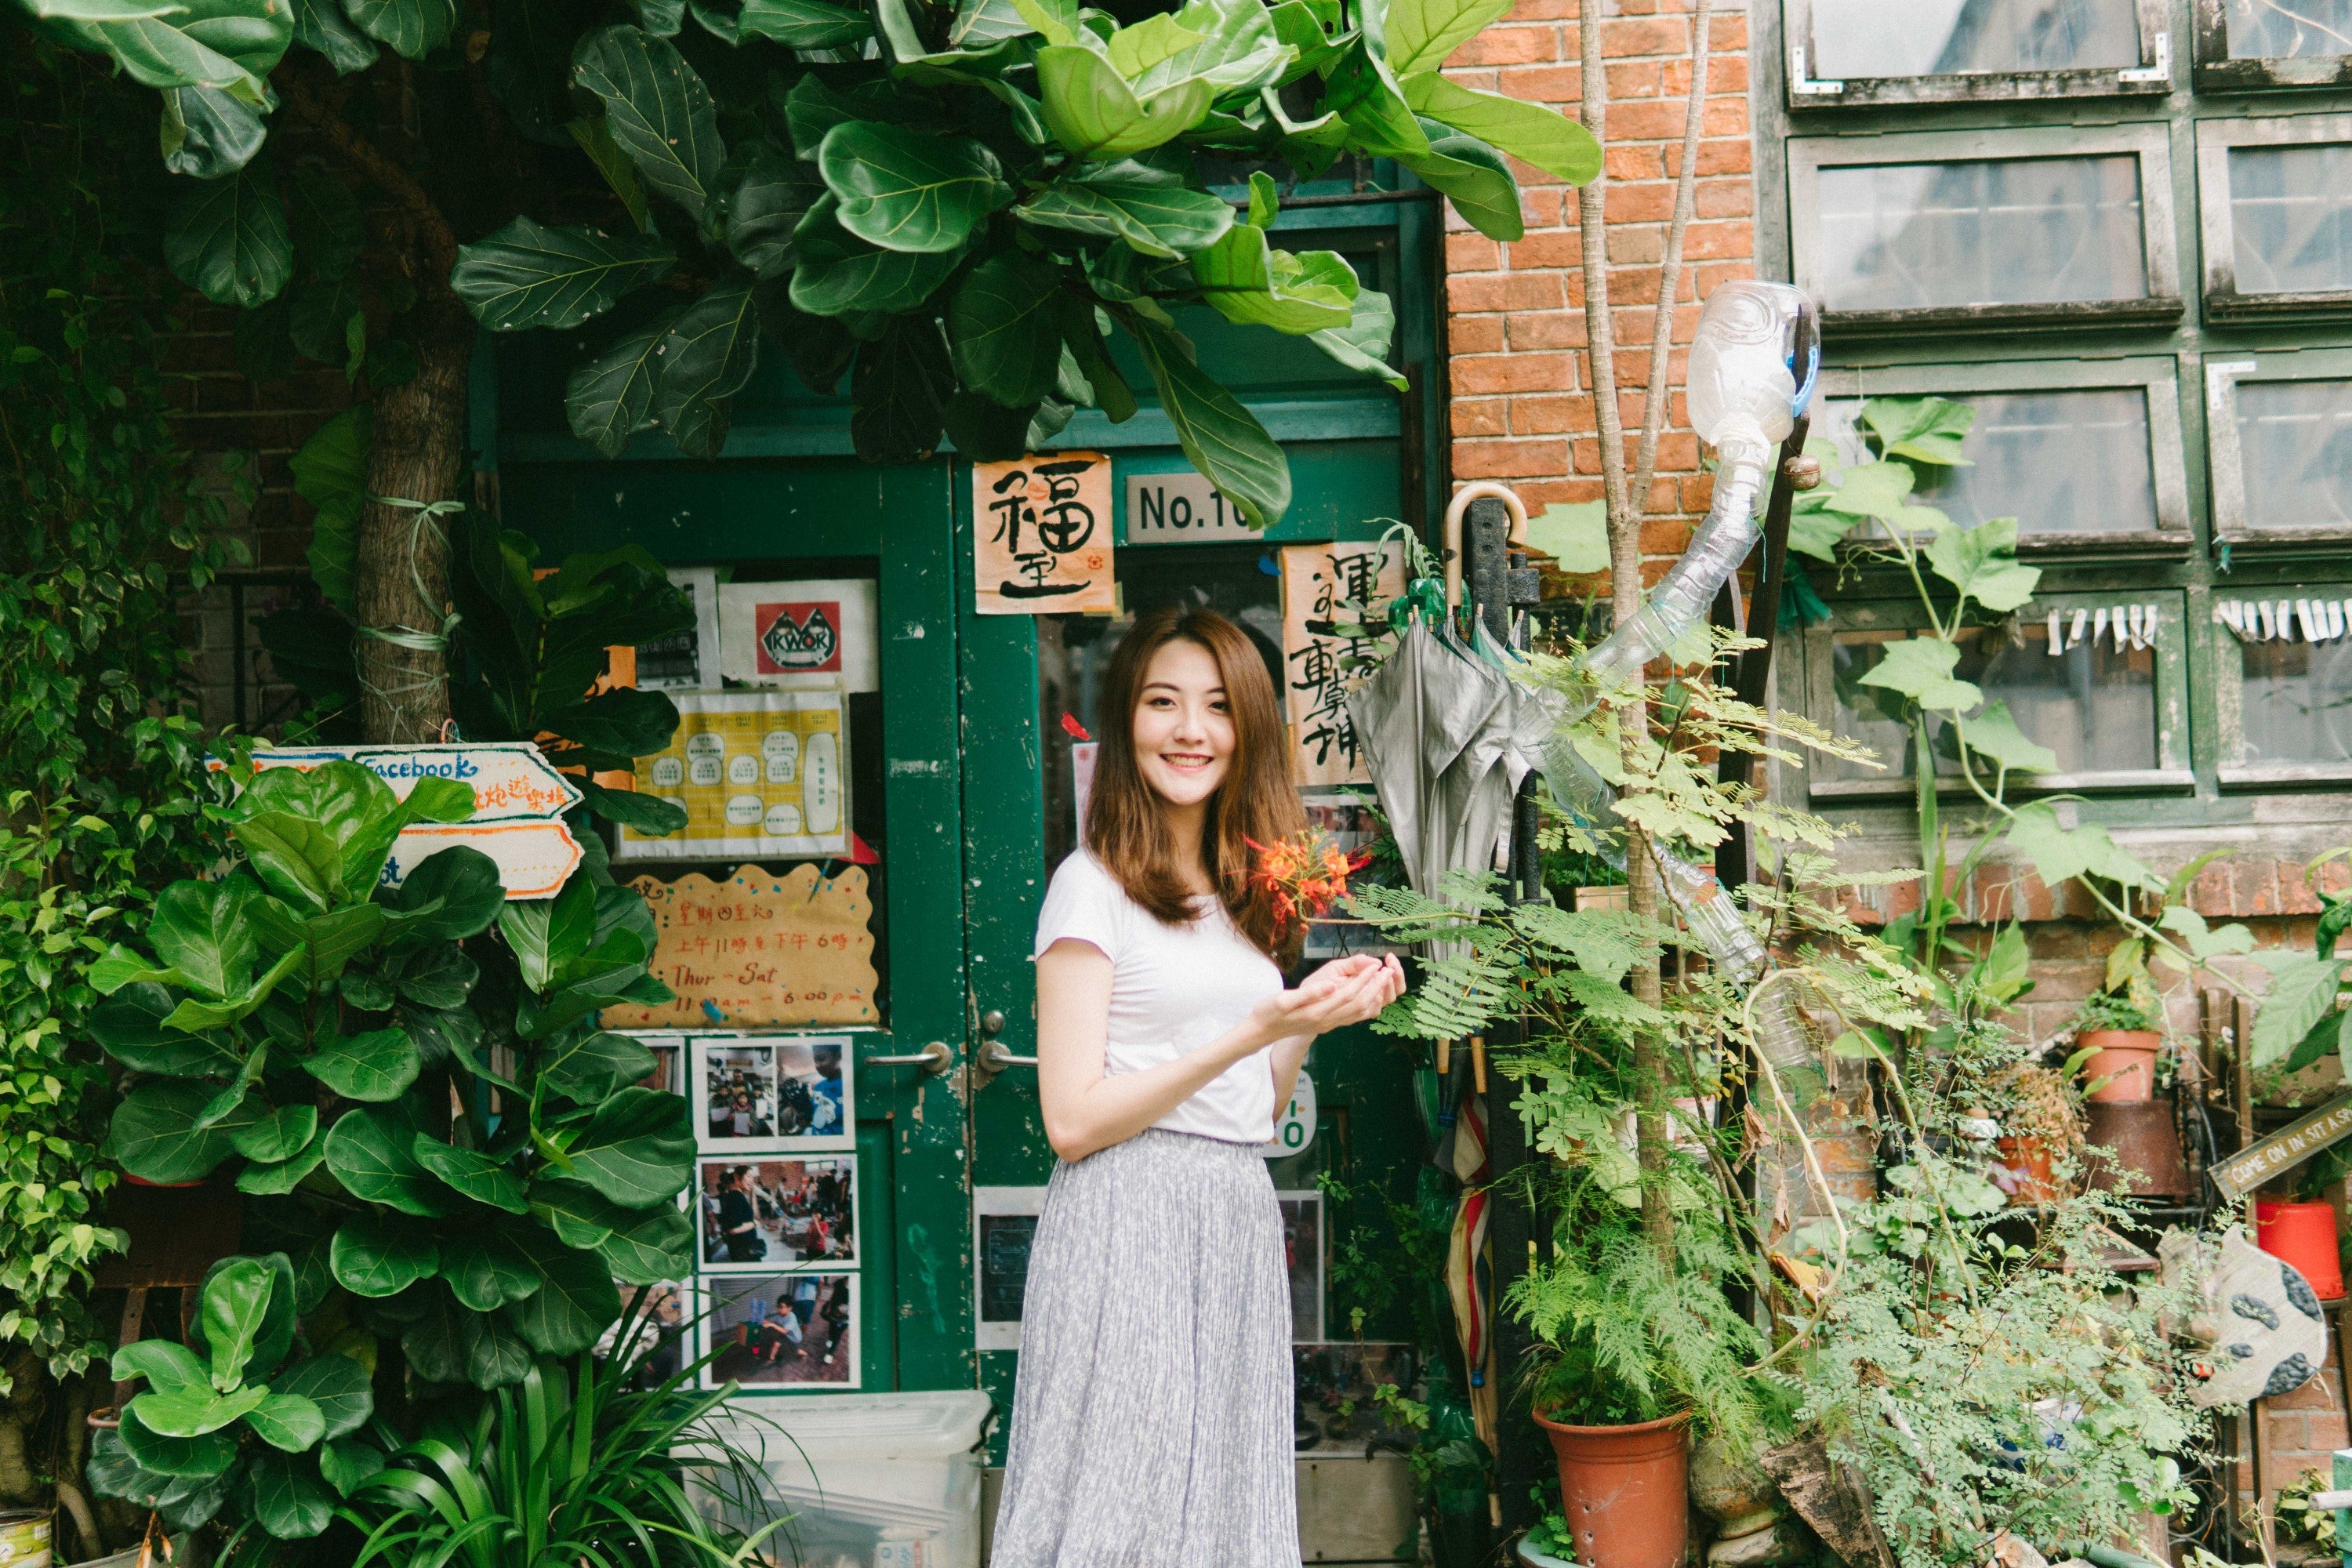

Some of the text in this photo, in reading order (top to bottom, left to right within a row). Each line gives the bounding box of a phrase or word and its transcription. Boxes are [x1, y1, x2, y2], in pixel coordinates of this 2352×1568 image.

[772, 633, 829, 650] KWOK
[739, 961, 778, 986] Sat
[2231, 1155, 2268, 1183] COME
[2267, 1143, 2288, 1163] ON
[2288, 1133, 2307, 1152] IN
[2306, 1121, 2328, 1142] SIT
[2327, 1116, 2341, 1131] A
